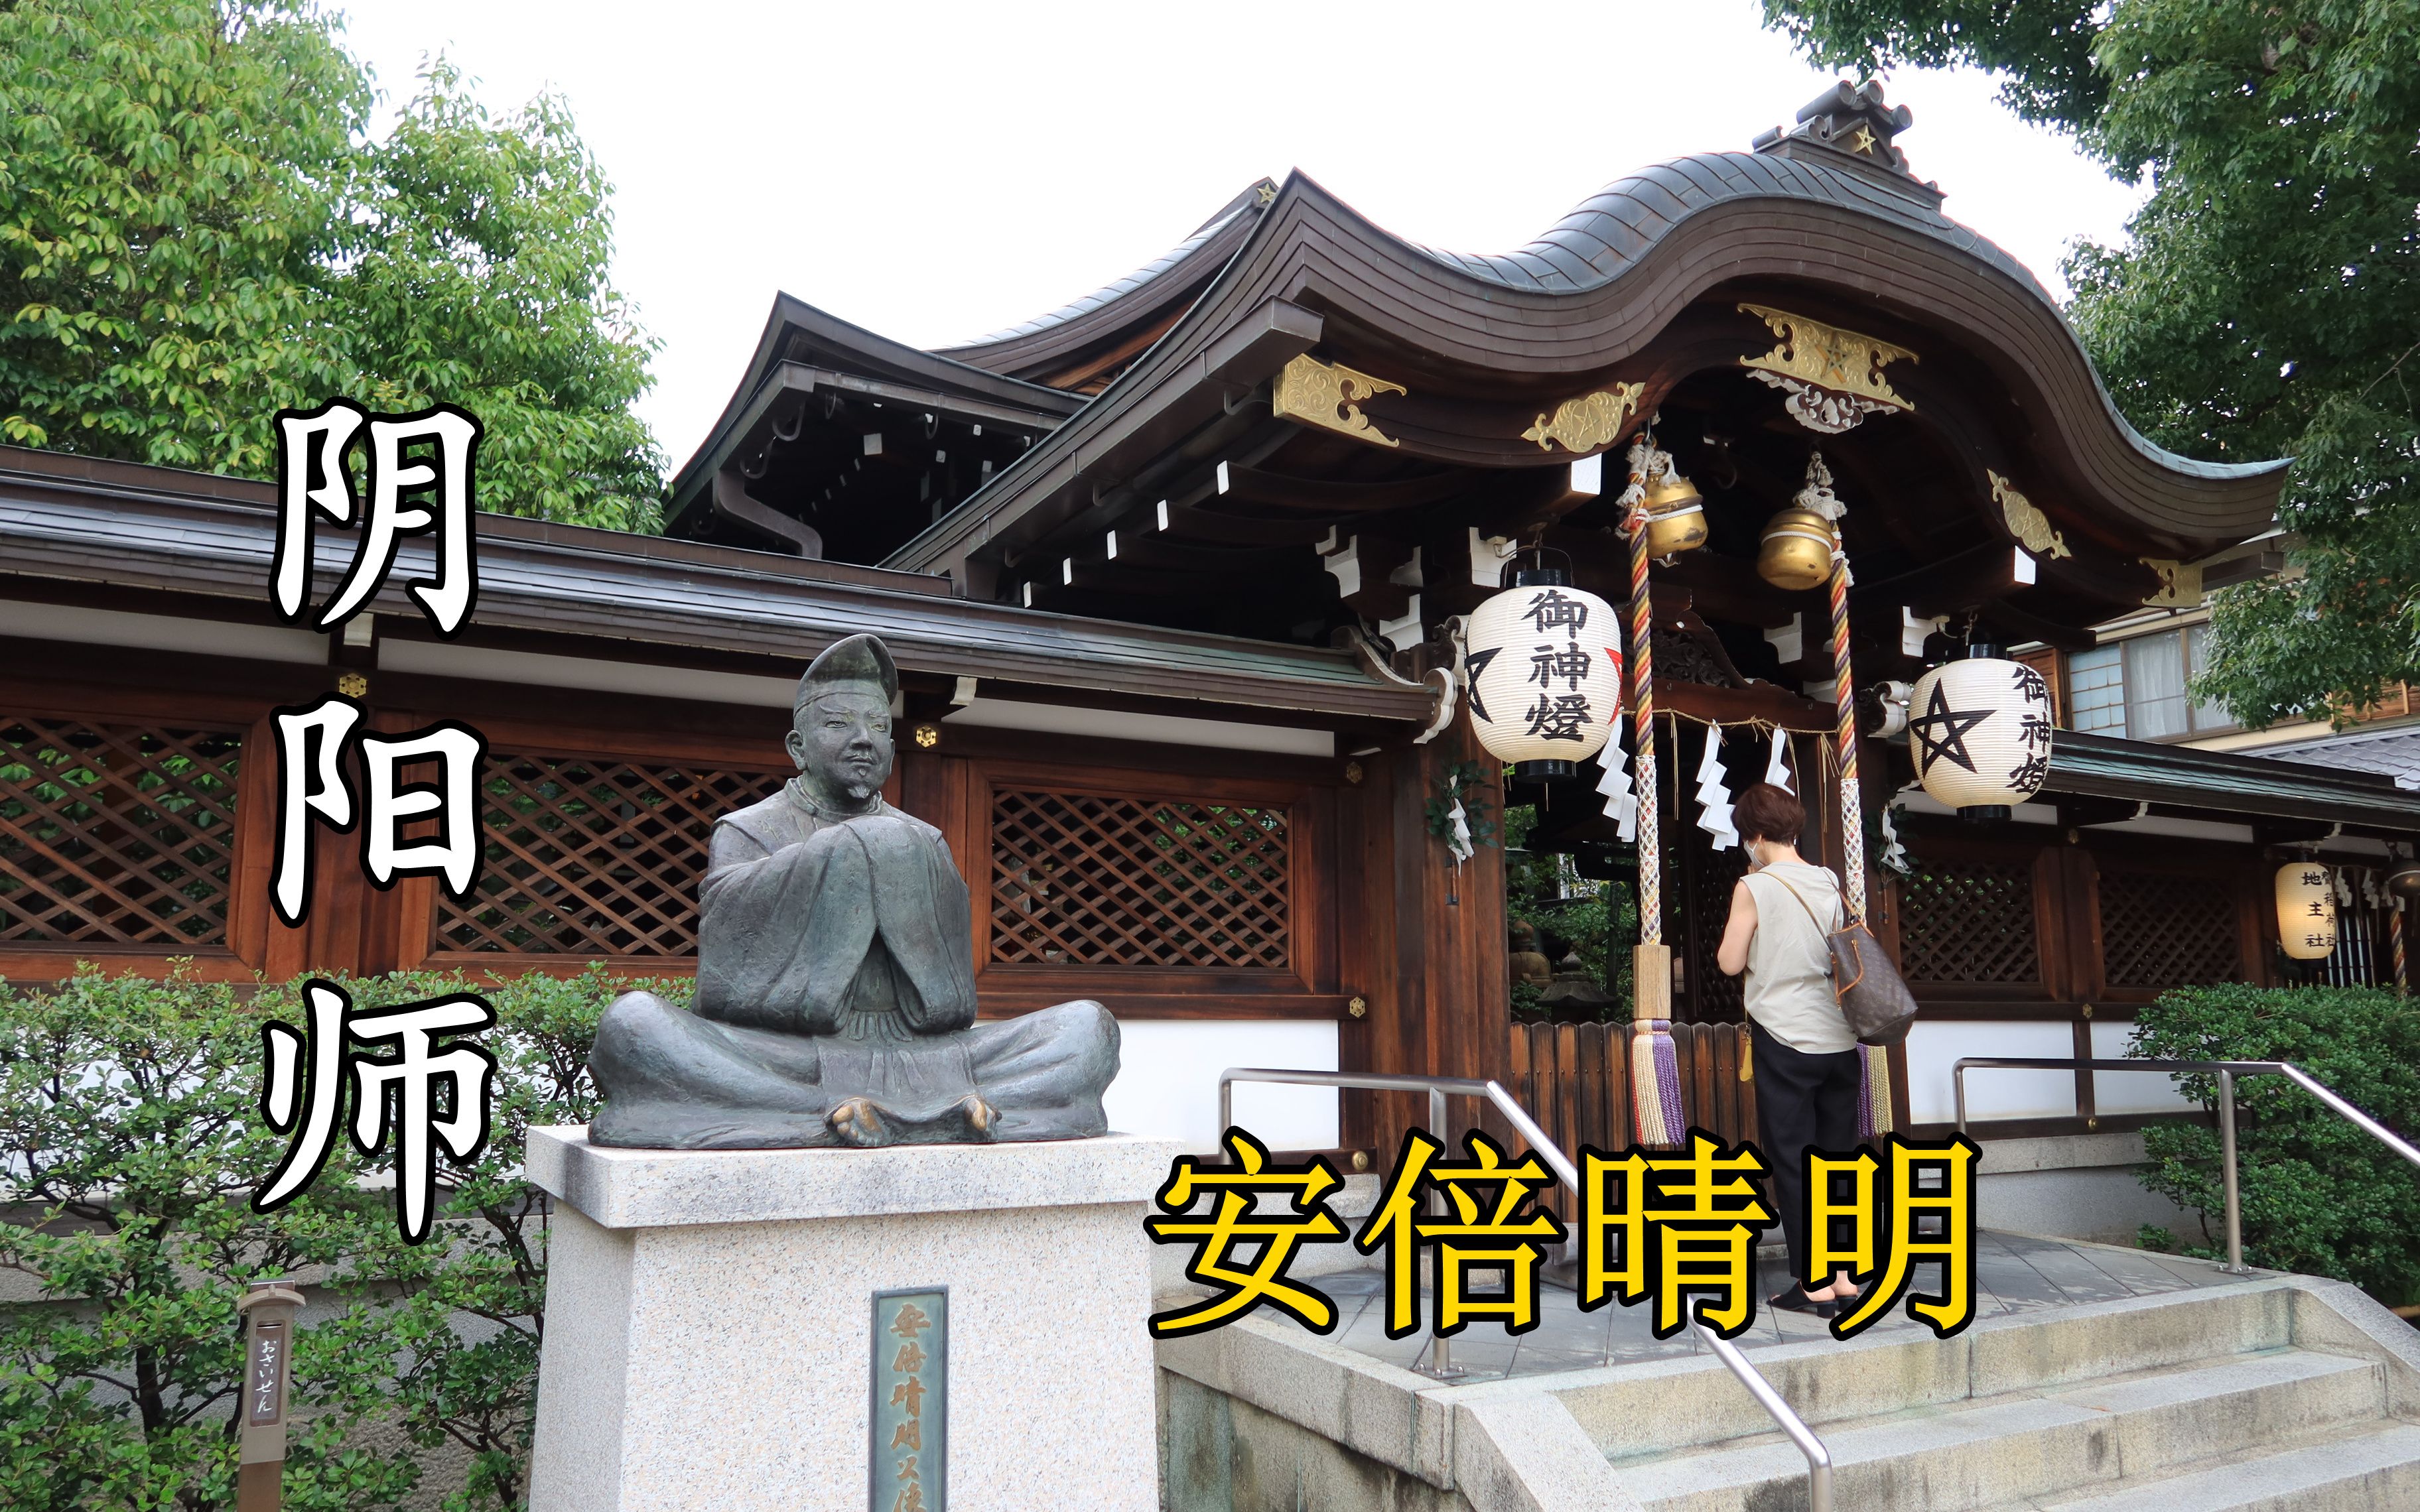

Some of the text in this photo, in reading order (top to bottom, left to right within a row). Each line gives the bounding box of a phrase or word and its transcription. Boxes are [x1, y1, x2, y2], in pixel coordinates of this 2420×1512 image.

[1520, 589, 1593, 742] 御神燈
[2301, 871, 2325, 948] 地主社
[255, 1340, 277, 1414] おさいせん
